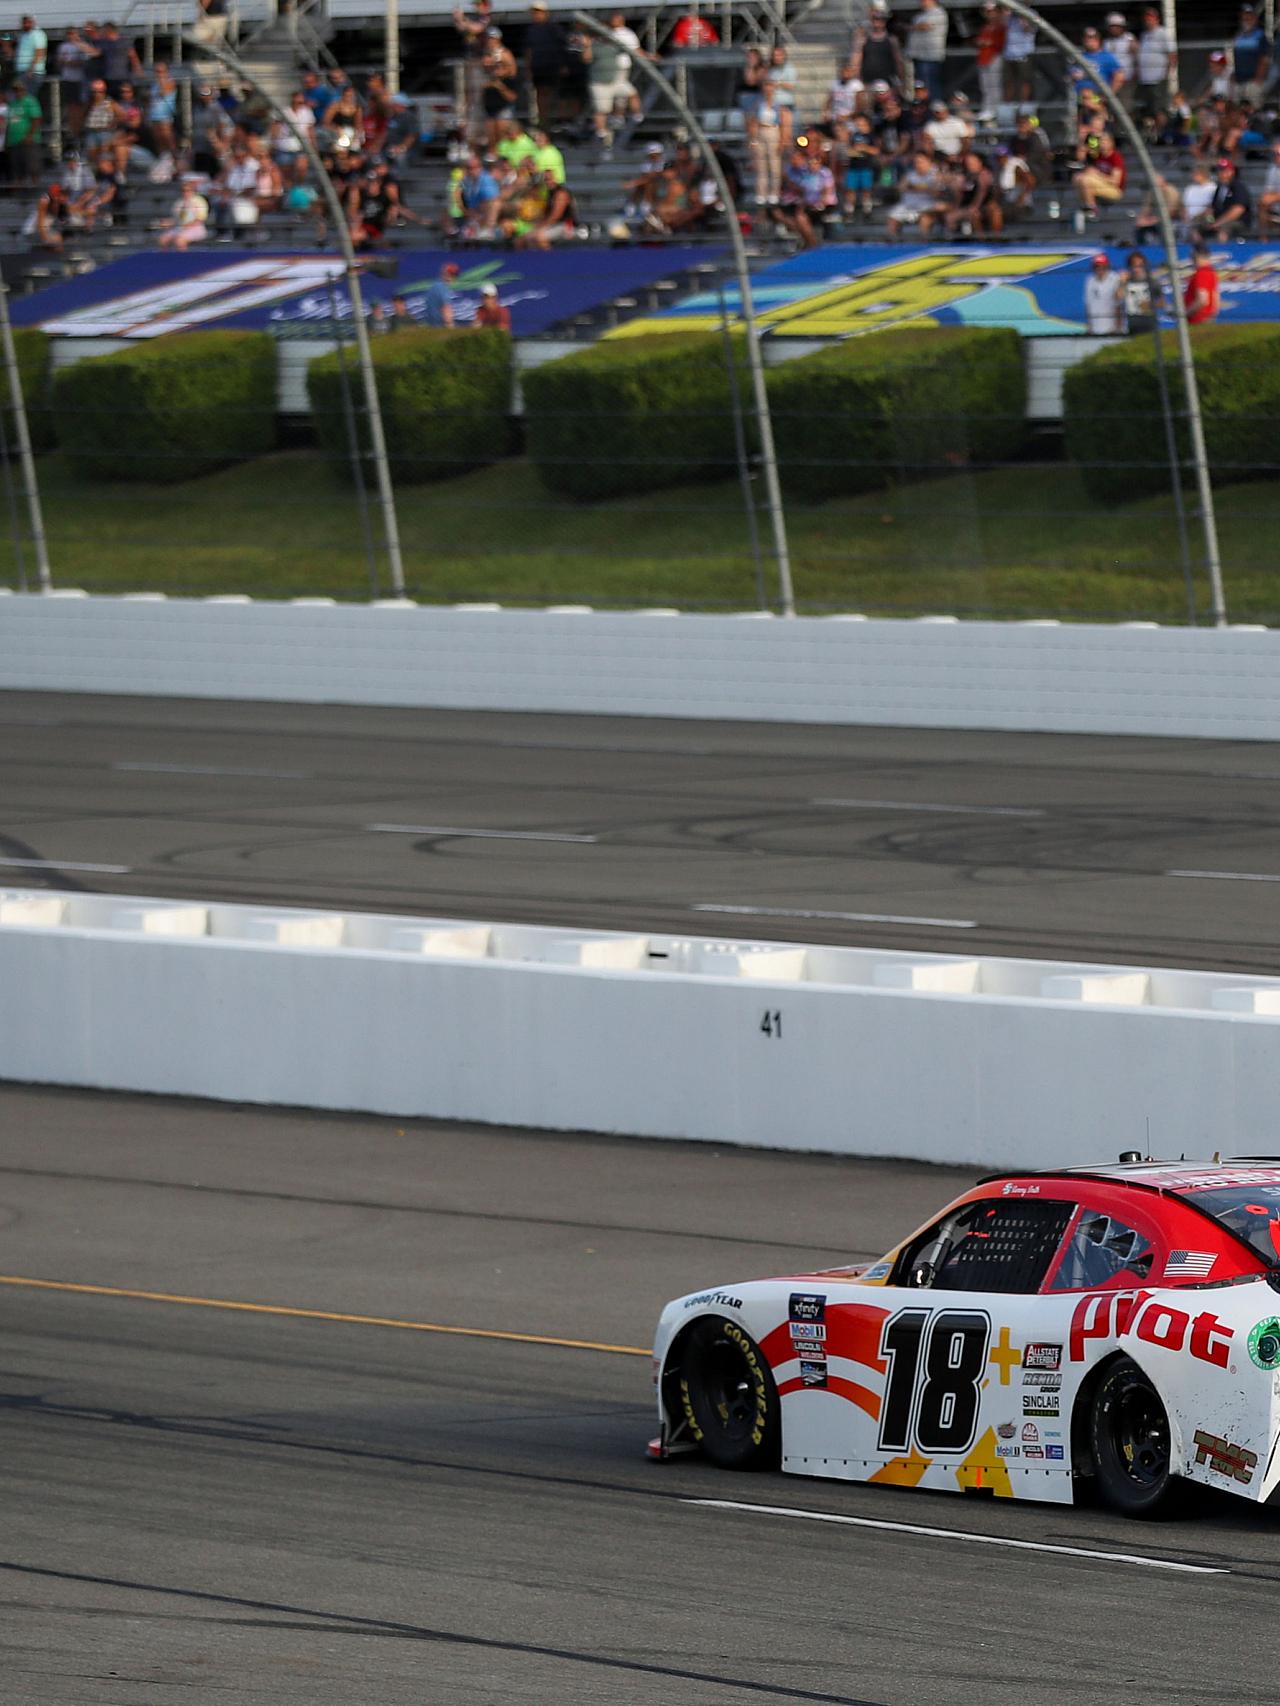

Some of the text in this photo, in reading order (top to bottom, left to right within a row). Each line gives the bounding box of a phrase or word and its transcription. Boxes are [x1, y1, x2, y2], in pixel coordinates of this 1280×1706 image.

[760, 1010, 782, 1038] 41
[684, 1290, 743, 1310] GOODYEAR
[794, 1302, 820, 1316] xfinity
[791, 1324, 815, 1337] Mobil
[1027, 1345, 1060, 1357] ALLSTATE
[877, 1306, 992, 1455] 18
[1023, 1395, 1060, 1409] SINCLAIR
